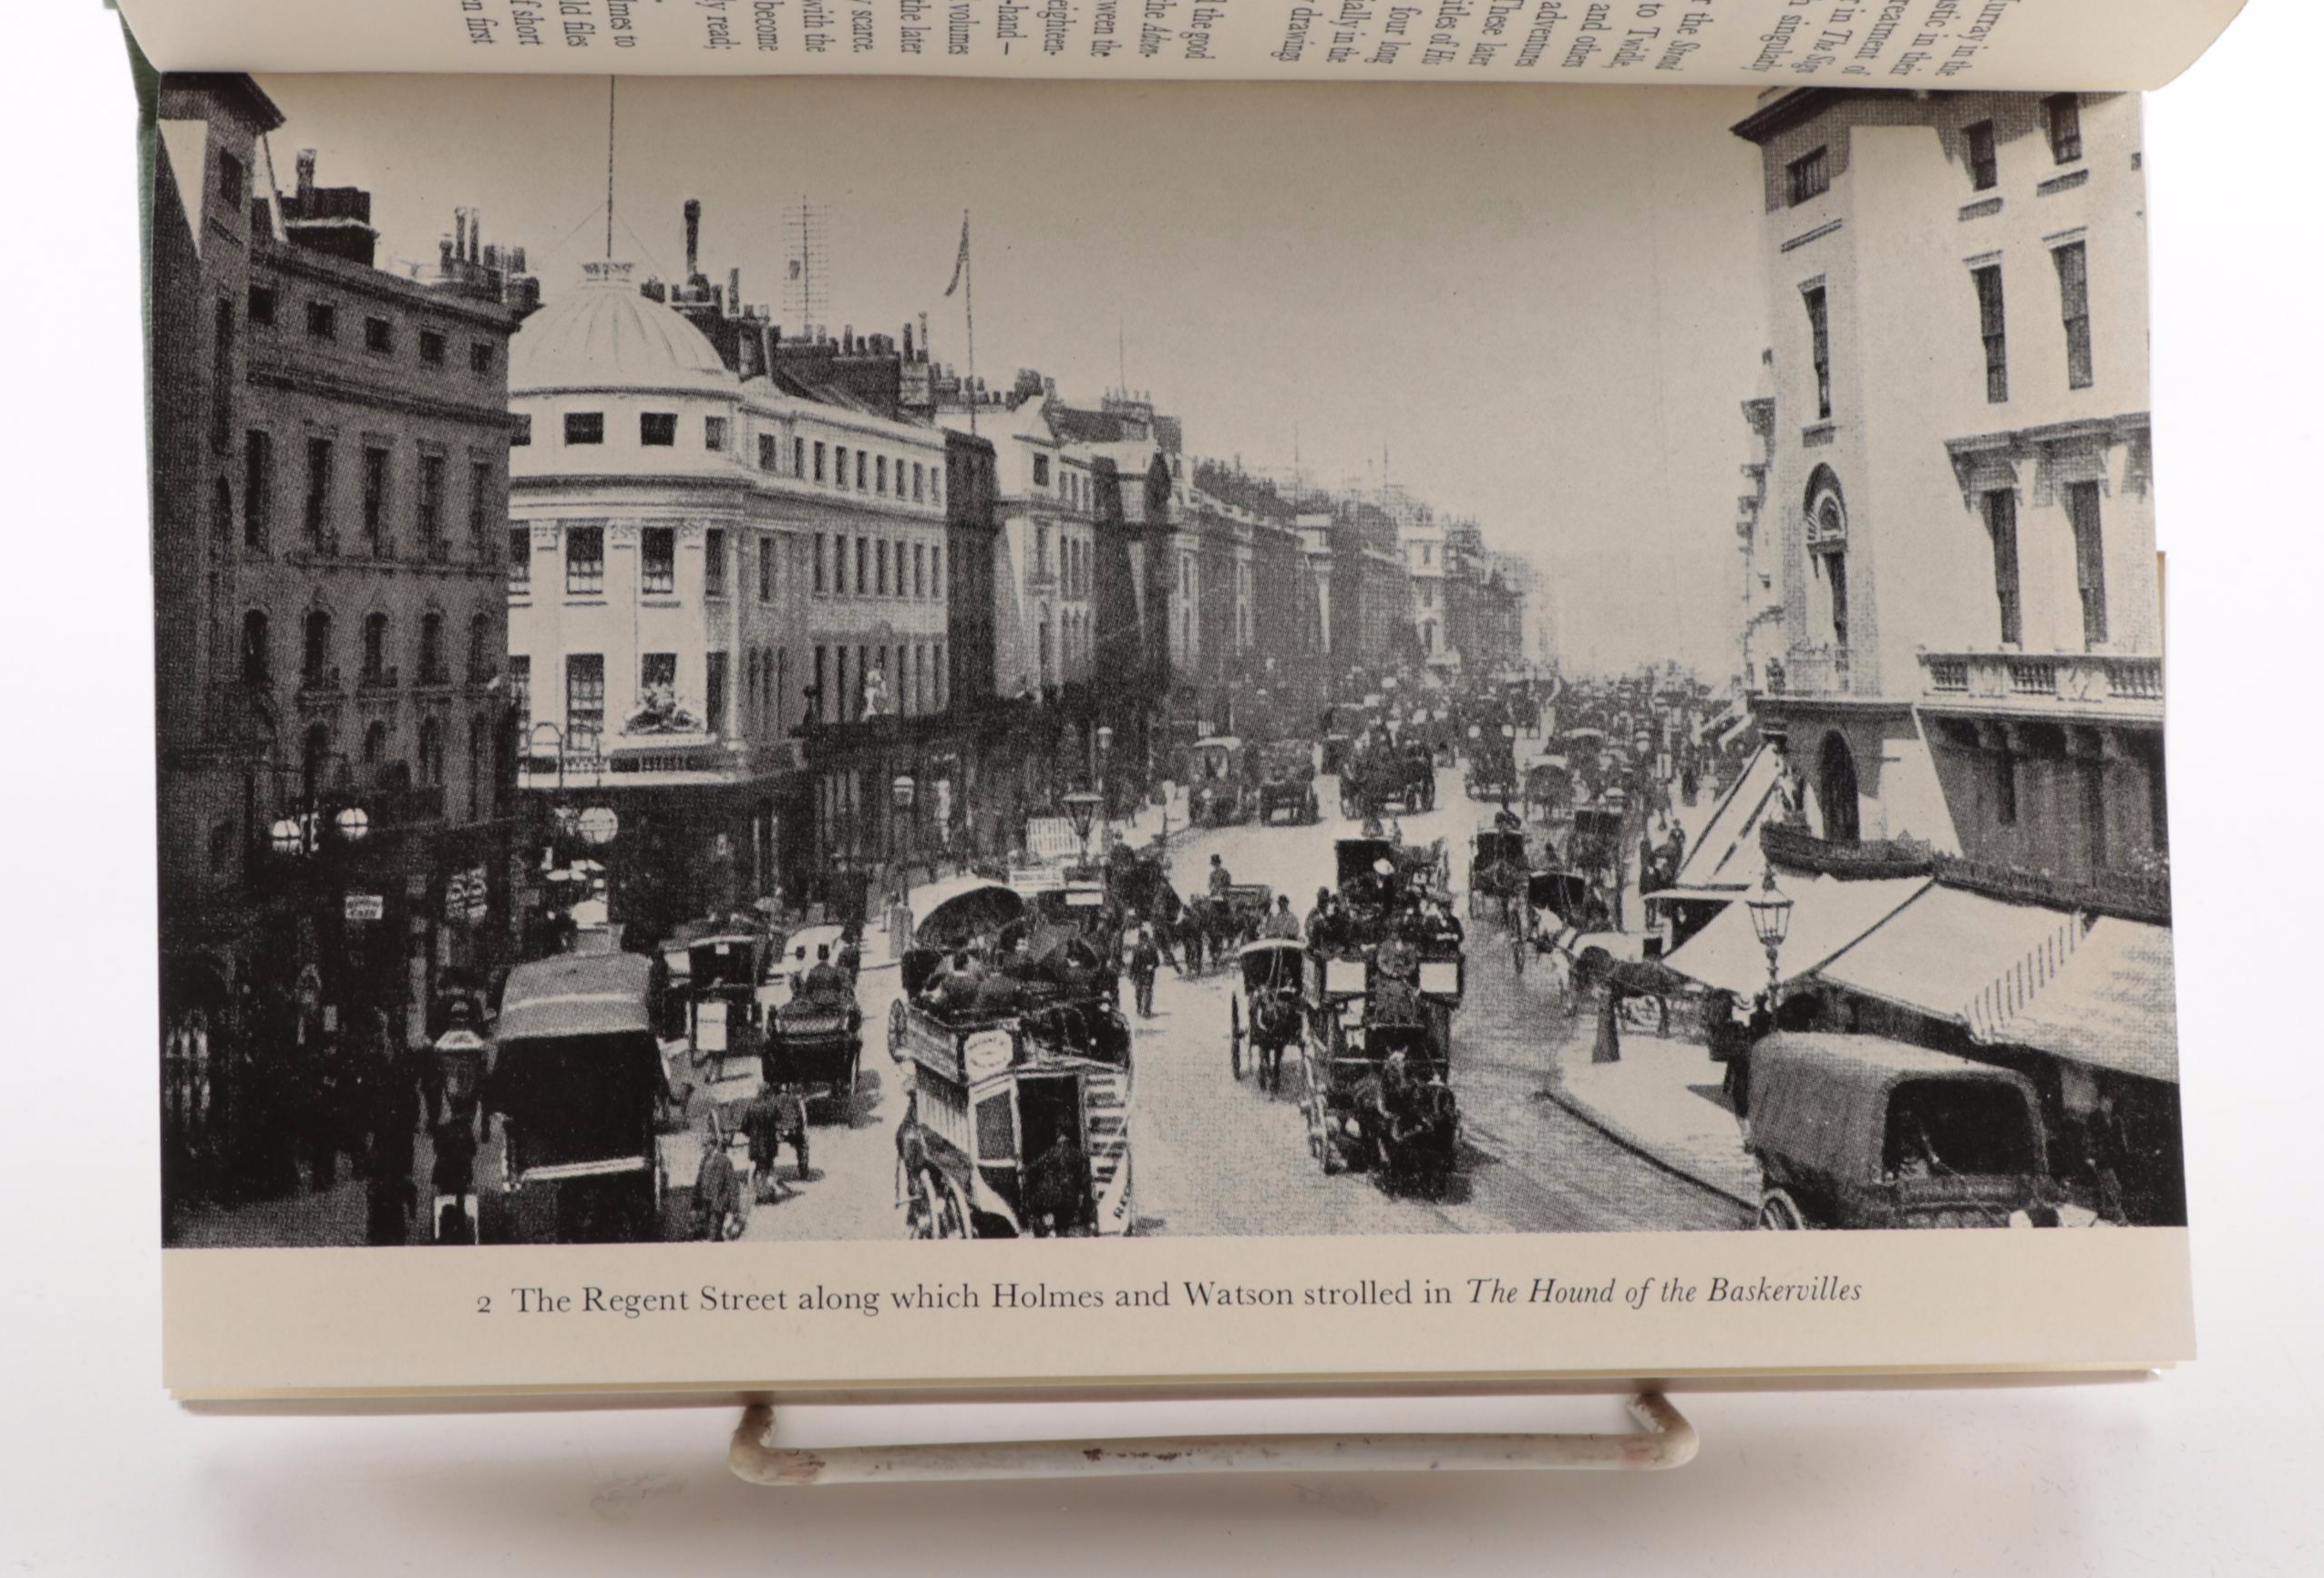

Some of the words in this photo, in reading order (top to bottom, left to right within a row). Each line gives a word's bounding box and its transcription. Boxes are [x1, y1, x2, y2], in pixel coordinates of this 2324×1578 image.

[559, 0, 591, 15] ld
[997, 0, 1030, 38] -hand
[1094, 0, 1116, 35] ween
[1191, 7, 1224, 29] the
[1385, 6, 1422, 36] four
[1435, 0, 1474, 29] itles
[1579, 3, 1612, 31] and
[1636, 3, 1664, 18] to
[1829, 7, 1866, 23] in
[1957, 0, 2009, 42] urray
[466, 17, 499, 44] first
[512, 10, 545, 46] short
[563, 21, 596, 46] files
[704, 15, 740, 49] read;
[754, 0, 785, 51] become
[851, 10, 873, 53] scarce.
[949, 4, 980, 55] volumes
[1270, 7, 1322, 62] drawings
[1515, 1, 1568, 67] adventures
[1677, 12, 1713, 35] the
[1855, 0, 1906, 59] reatment
[613, 35, 638, 47] to
[805, 33, 837, 53] the
[900, 26, 931, 55] later
[1091, 39, 1122, 57] the
[1139, 23, 1173, 57] Adven-
[1179, 32, 1216, 59] good
[1333, 31, 1366, 44] in
[1429, 33, 1460, 46] of
[1561, 35, 1601, 67] others
[1601, 27, 1661, 69] Twidle,
[1741, 15, 1810, 72] singularly
[1814, 29, 1853, 51] The
[1912, 33, 1949, 46] in
[1951, 45, 1989, 57] in
[1326, 46, 1360, 64] the
[1364, 41, 1412, 64] long
[1422, 48, 1456, 65] His
[1468, 42, 1507, 67] later
[1654, 39, 1702, 71] Strand
[1791, 53, 1836, 73] Sign
[1889, 51, 1931, 76] their
[1842, 65, 1871, 76] of
[1935, 60, 1972, 77] the
[477, 1295, 492, 1314] 2
[511, 1287, 571, 1313] The
[581, 1286, 690, 1318] Regent
[700, 1285, 788, 1312] Street
[798, 1284, 880, 1315] along
[890, 1283, 982, 1310] which
[992, 1282, 1105, 1308] Holmes
[1115, 1281, 1171, 1307] and
[1183, 1281, 1294, 1306] Watson
[1304, 1279, 1413, 1305] strolled
[1424, 1279, 1454, 1304] in
[1466, 1278, 1518, 1304] The
[1527, 1277, 1616, 1304] Hound
[1625, 1277, 1656, 1310] of
[1661, 1276, 1697, 1303] the
[1707, 1275, 1863, 1303] Baskervilles
